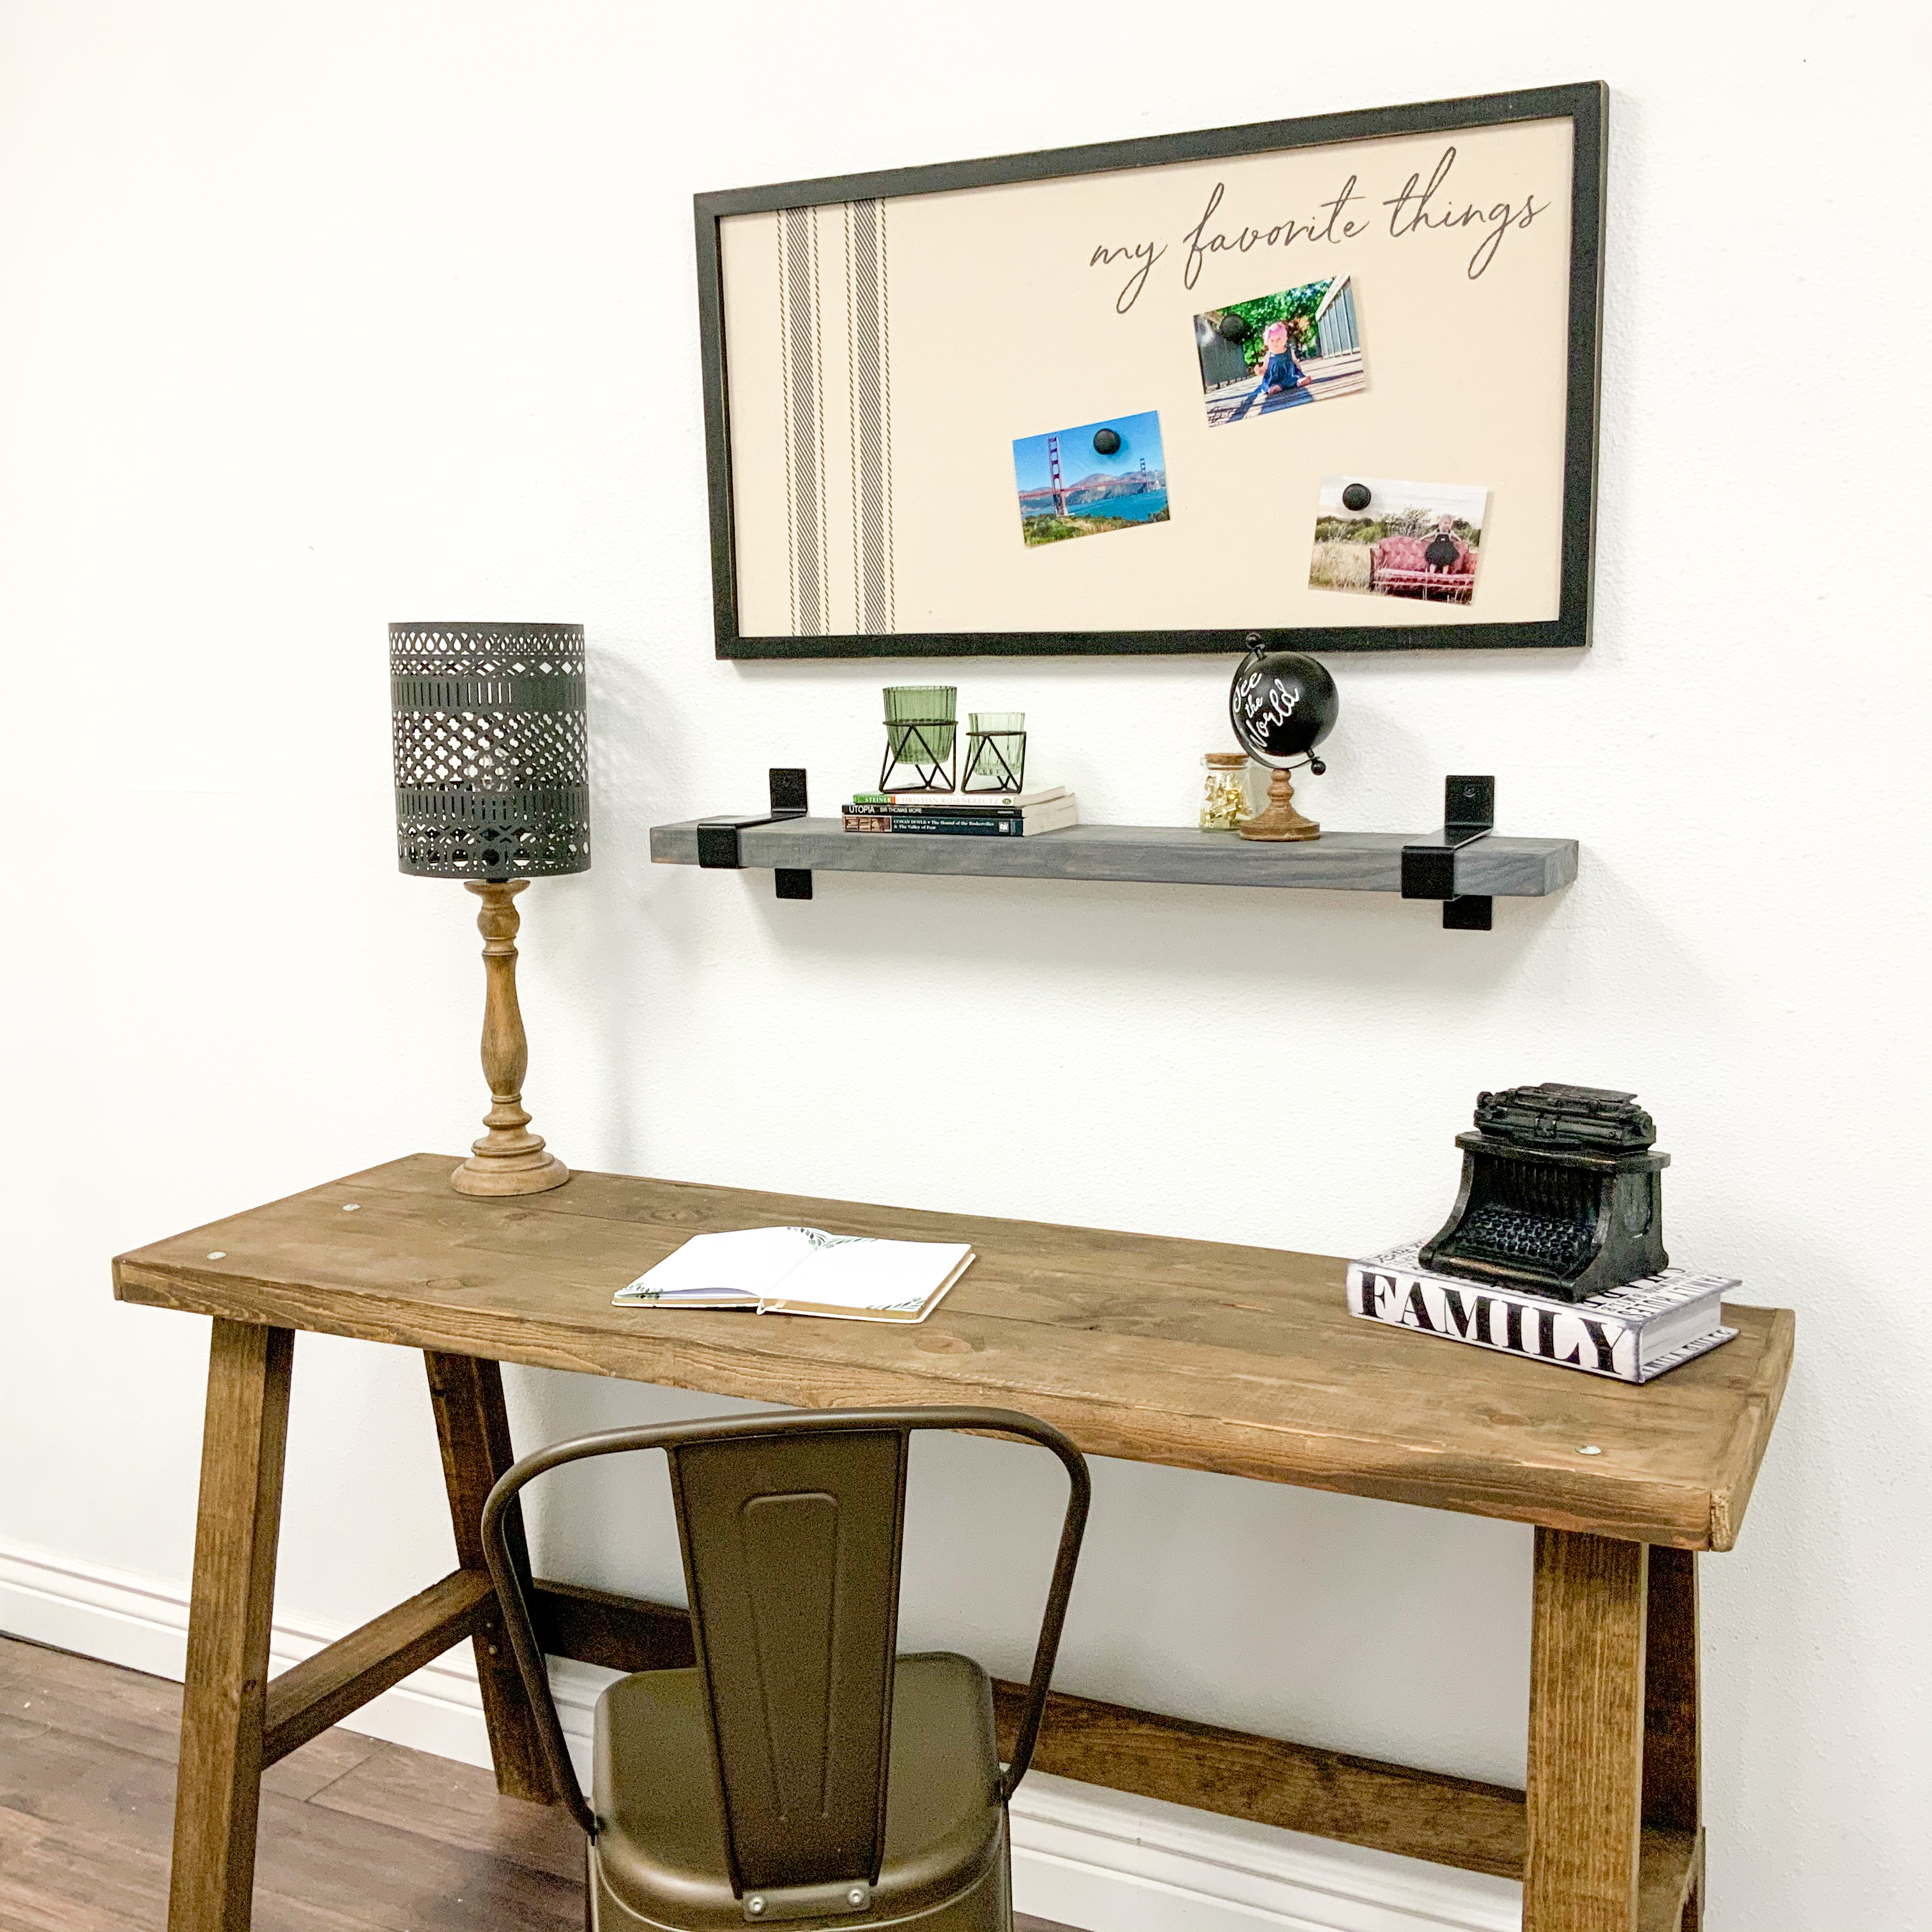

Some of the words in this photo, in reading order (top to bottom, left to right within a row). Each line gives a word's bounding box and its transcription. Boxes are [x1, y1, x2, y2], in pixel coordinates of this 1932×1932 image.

[1090, 242, 1169, 314] my
[1182, 175, 1371, 290] favorite
[1383, 146, 1552, 280] things
[1233, 672, 1262, 713] See
[1245, 694, 1264, 719] the
[848, 805, 875, 814] UTOPIA
[1358, 1270, 1631, 1376] FAMILY
